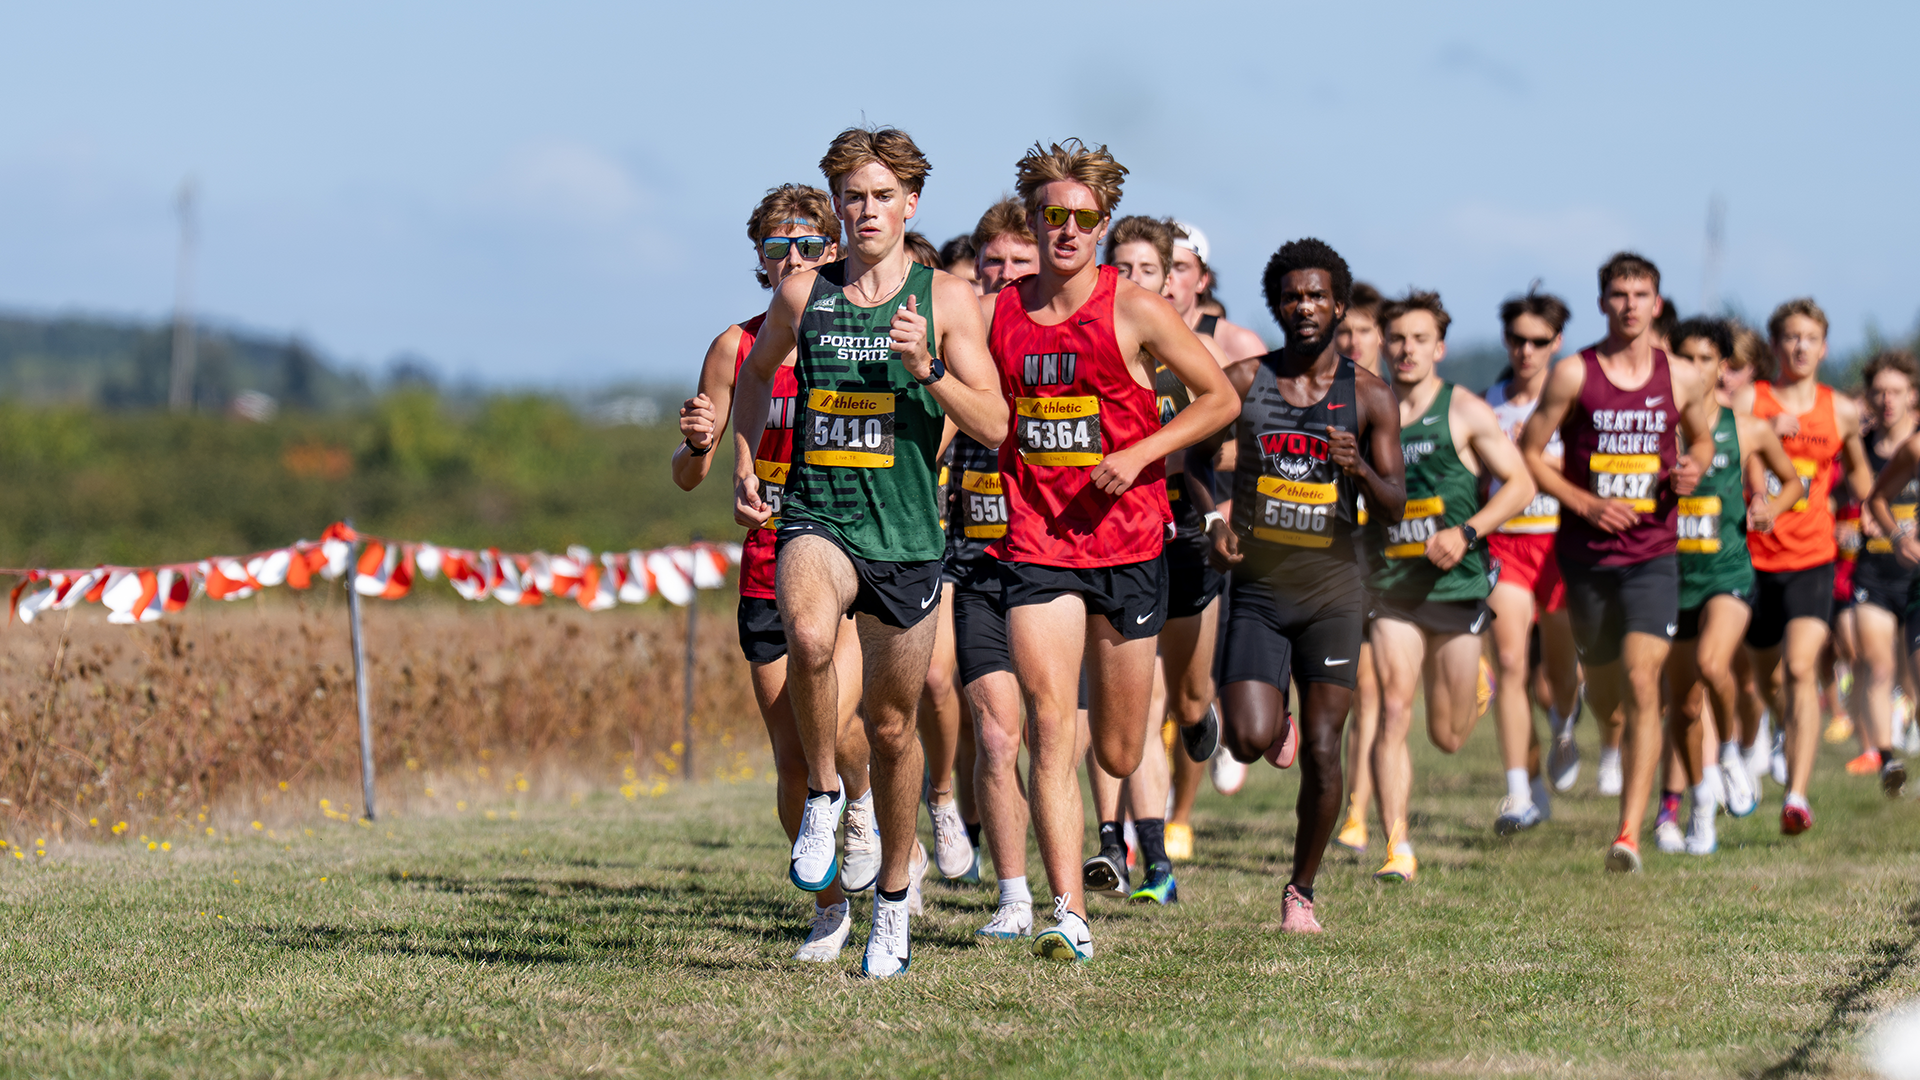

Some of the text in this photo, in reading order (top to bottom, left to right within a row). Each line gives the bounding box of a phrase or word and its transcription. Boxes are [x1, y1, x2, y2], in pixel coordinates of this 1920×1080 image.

[820, 335, 897, 348] PORTLAN
[837, 348, 889, 361] STATE
[1024, 352, 1077, 386] NNU
[820, 395, 877, 410] Athletic
[1030, 401, 1082, 413] Athletic
[814, 415, 882, 449] 5410
[1593, 410, 1667, 432] SEATTLE
[1027, 421, 1091, 449] 5364
[1597, 432, 1660, 454] PACIFIC
[1261, 433, 1329, 461] WOU
[973, 476, 1001, 489] Athl
[1272, 483, 1324, 499] Athletic
[1597, 473, 1653, 498] 5437
[970, 495, 1007, 522] 550
[1264, 499, 1327, 532] 5506
